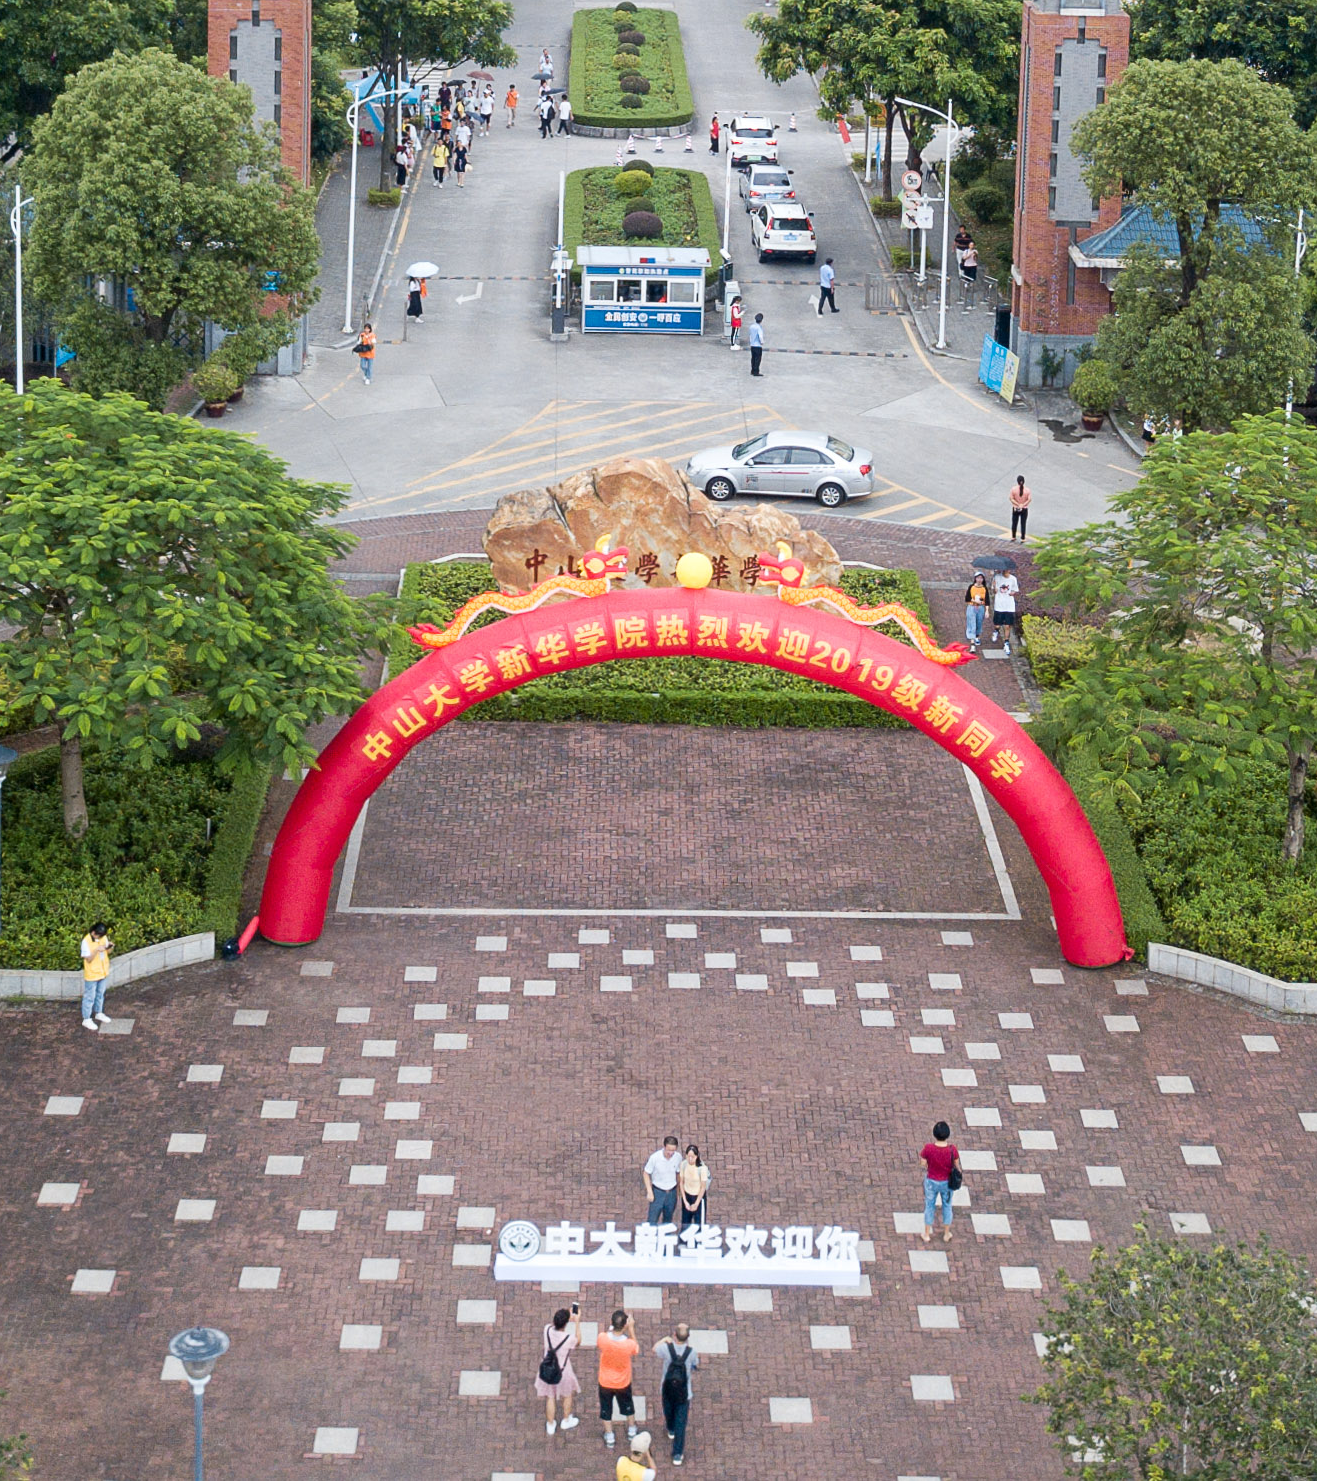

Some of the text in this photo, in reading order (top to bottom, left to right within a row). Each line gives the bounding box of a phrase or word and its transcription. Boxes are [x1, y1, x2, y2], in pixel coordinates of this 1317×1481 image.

[360, 611, 1027, 786] 中山大学新华学院热烈欢迎2019级新同学
[544, 1220, 861, 1264] 中大新华欢迎你
